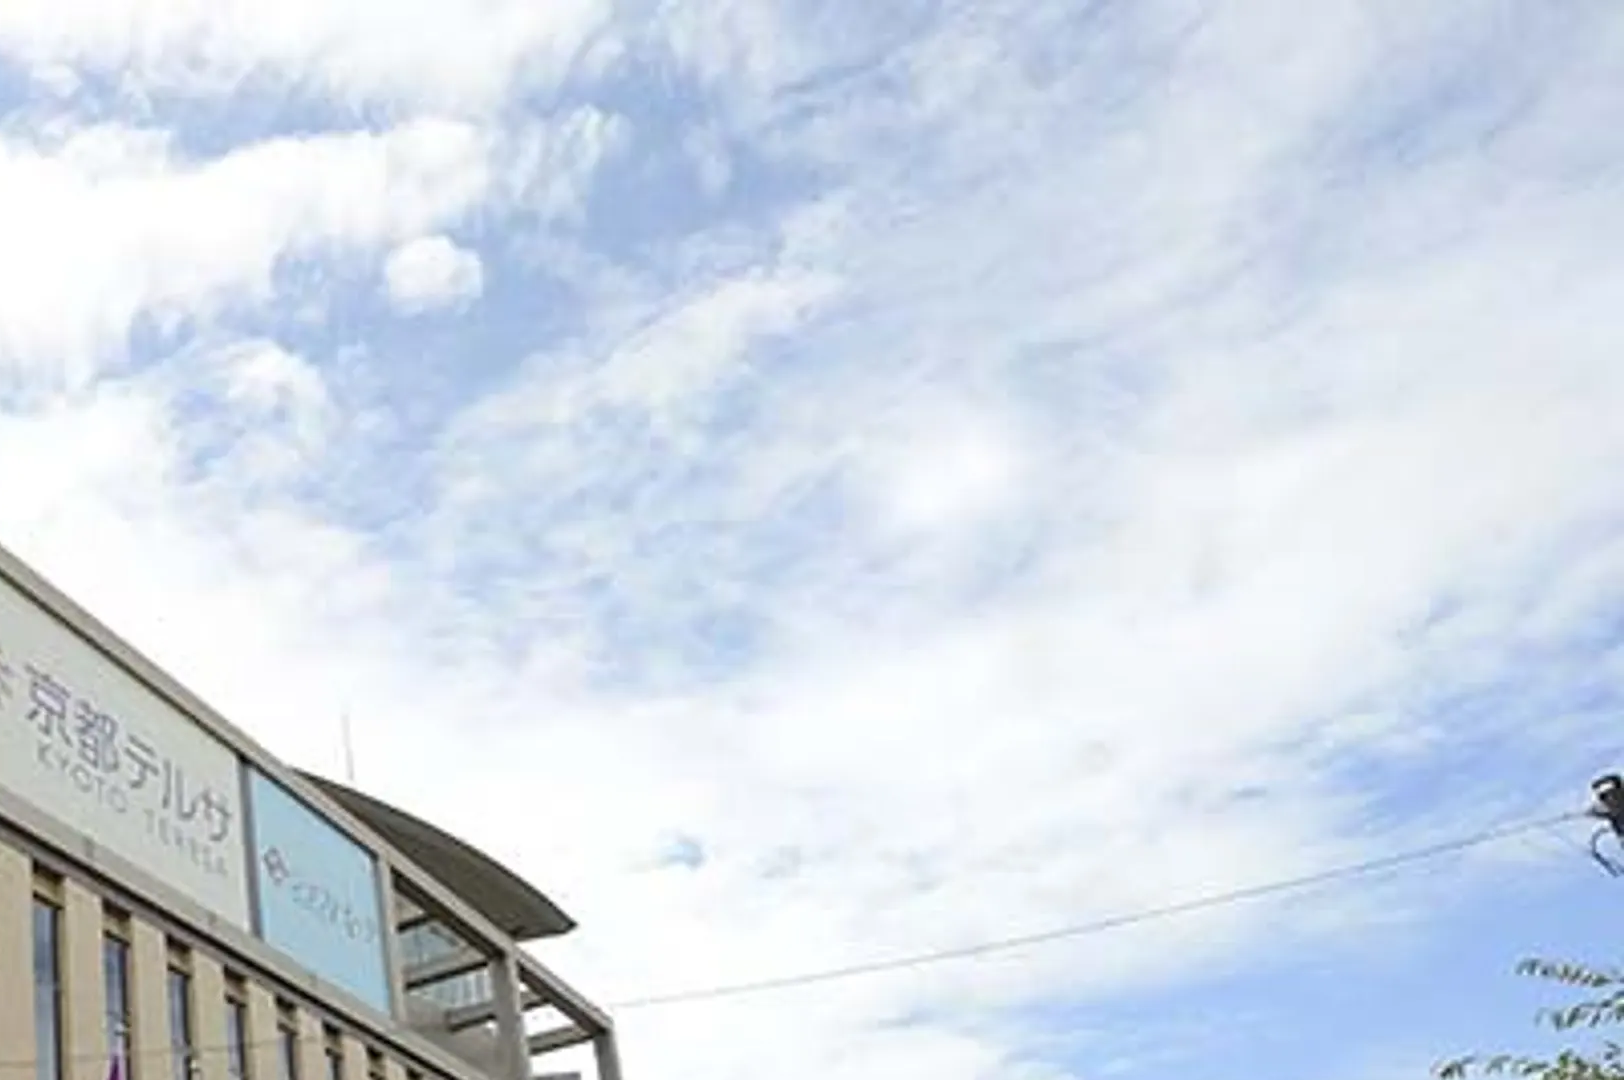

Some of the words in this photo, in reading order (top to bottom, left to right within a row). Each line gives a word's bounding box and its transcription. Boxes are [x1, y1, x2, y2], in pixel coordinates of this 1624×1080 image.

[26, 660, 231, 843] 京都テルサ
[37, 740, 128, 814] KYOTO
